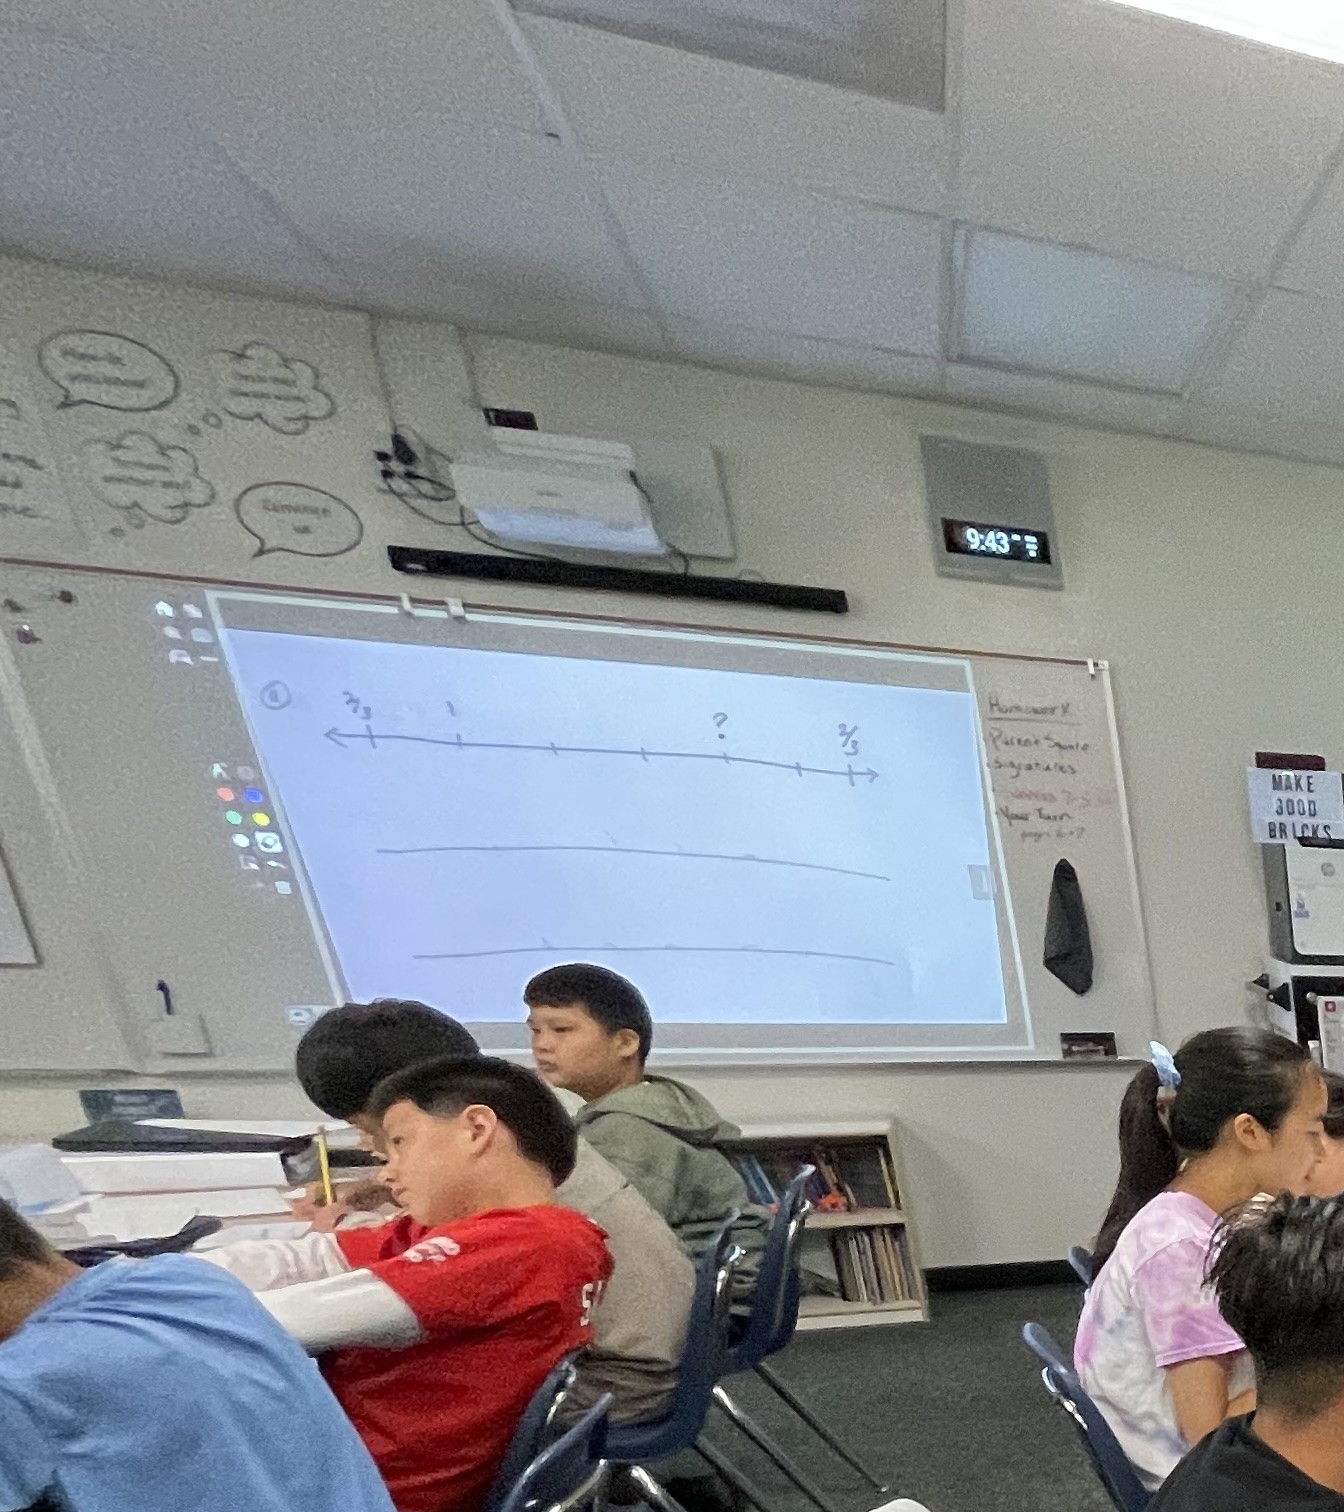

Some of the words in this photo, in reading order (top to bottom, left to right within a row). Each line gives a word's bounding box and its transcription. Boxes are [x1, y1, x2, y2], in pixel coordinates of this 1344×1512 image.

[966, 528, 1010, 554] 9:43
[1271, 773, 1315, 793] MAKE
[1268, 821, 1333, 840] BRICKS
